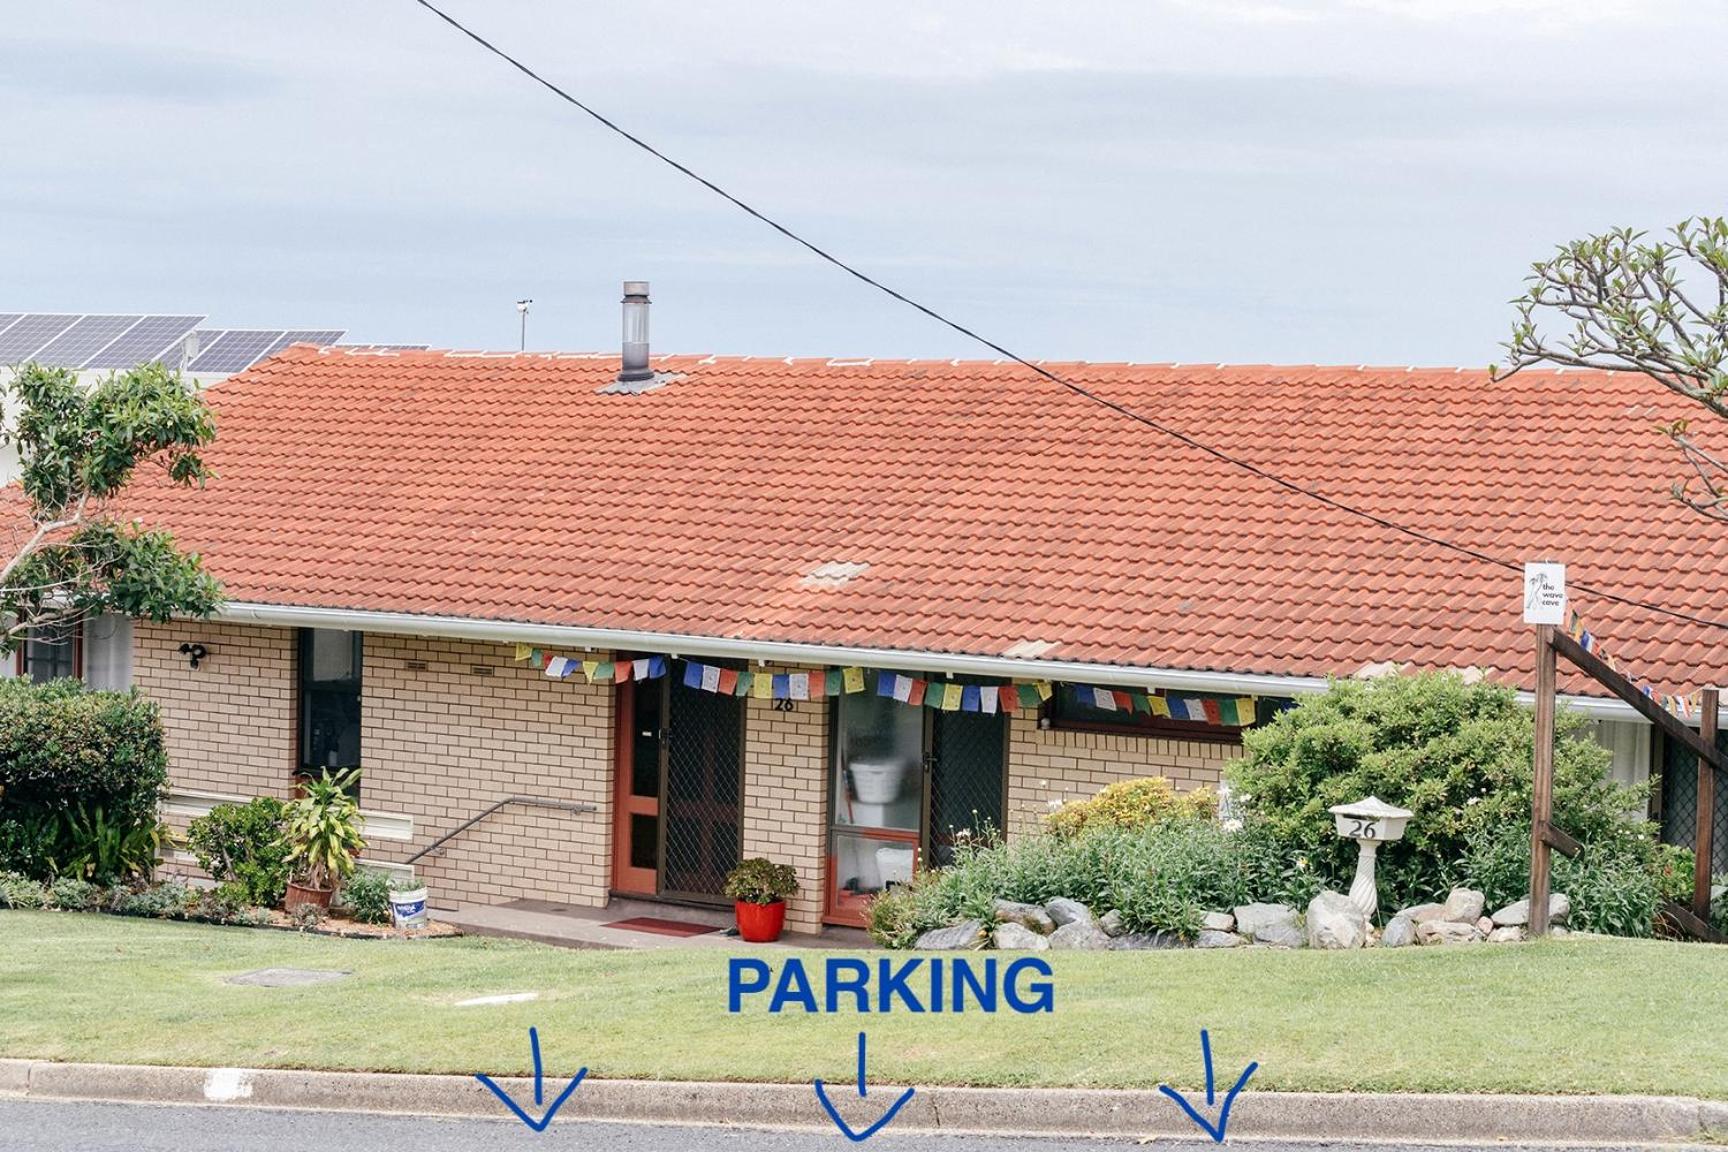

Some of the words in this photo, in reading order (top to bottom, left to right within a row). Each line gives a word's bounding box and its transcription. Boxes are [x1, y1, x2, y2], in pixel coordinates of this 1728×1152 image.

[1542, 582, 1555, 591] the
[774, 697, 794, 712] 26
[1349, 820, 1376, 839] 26
